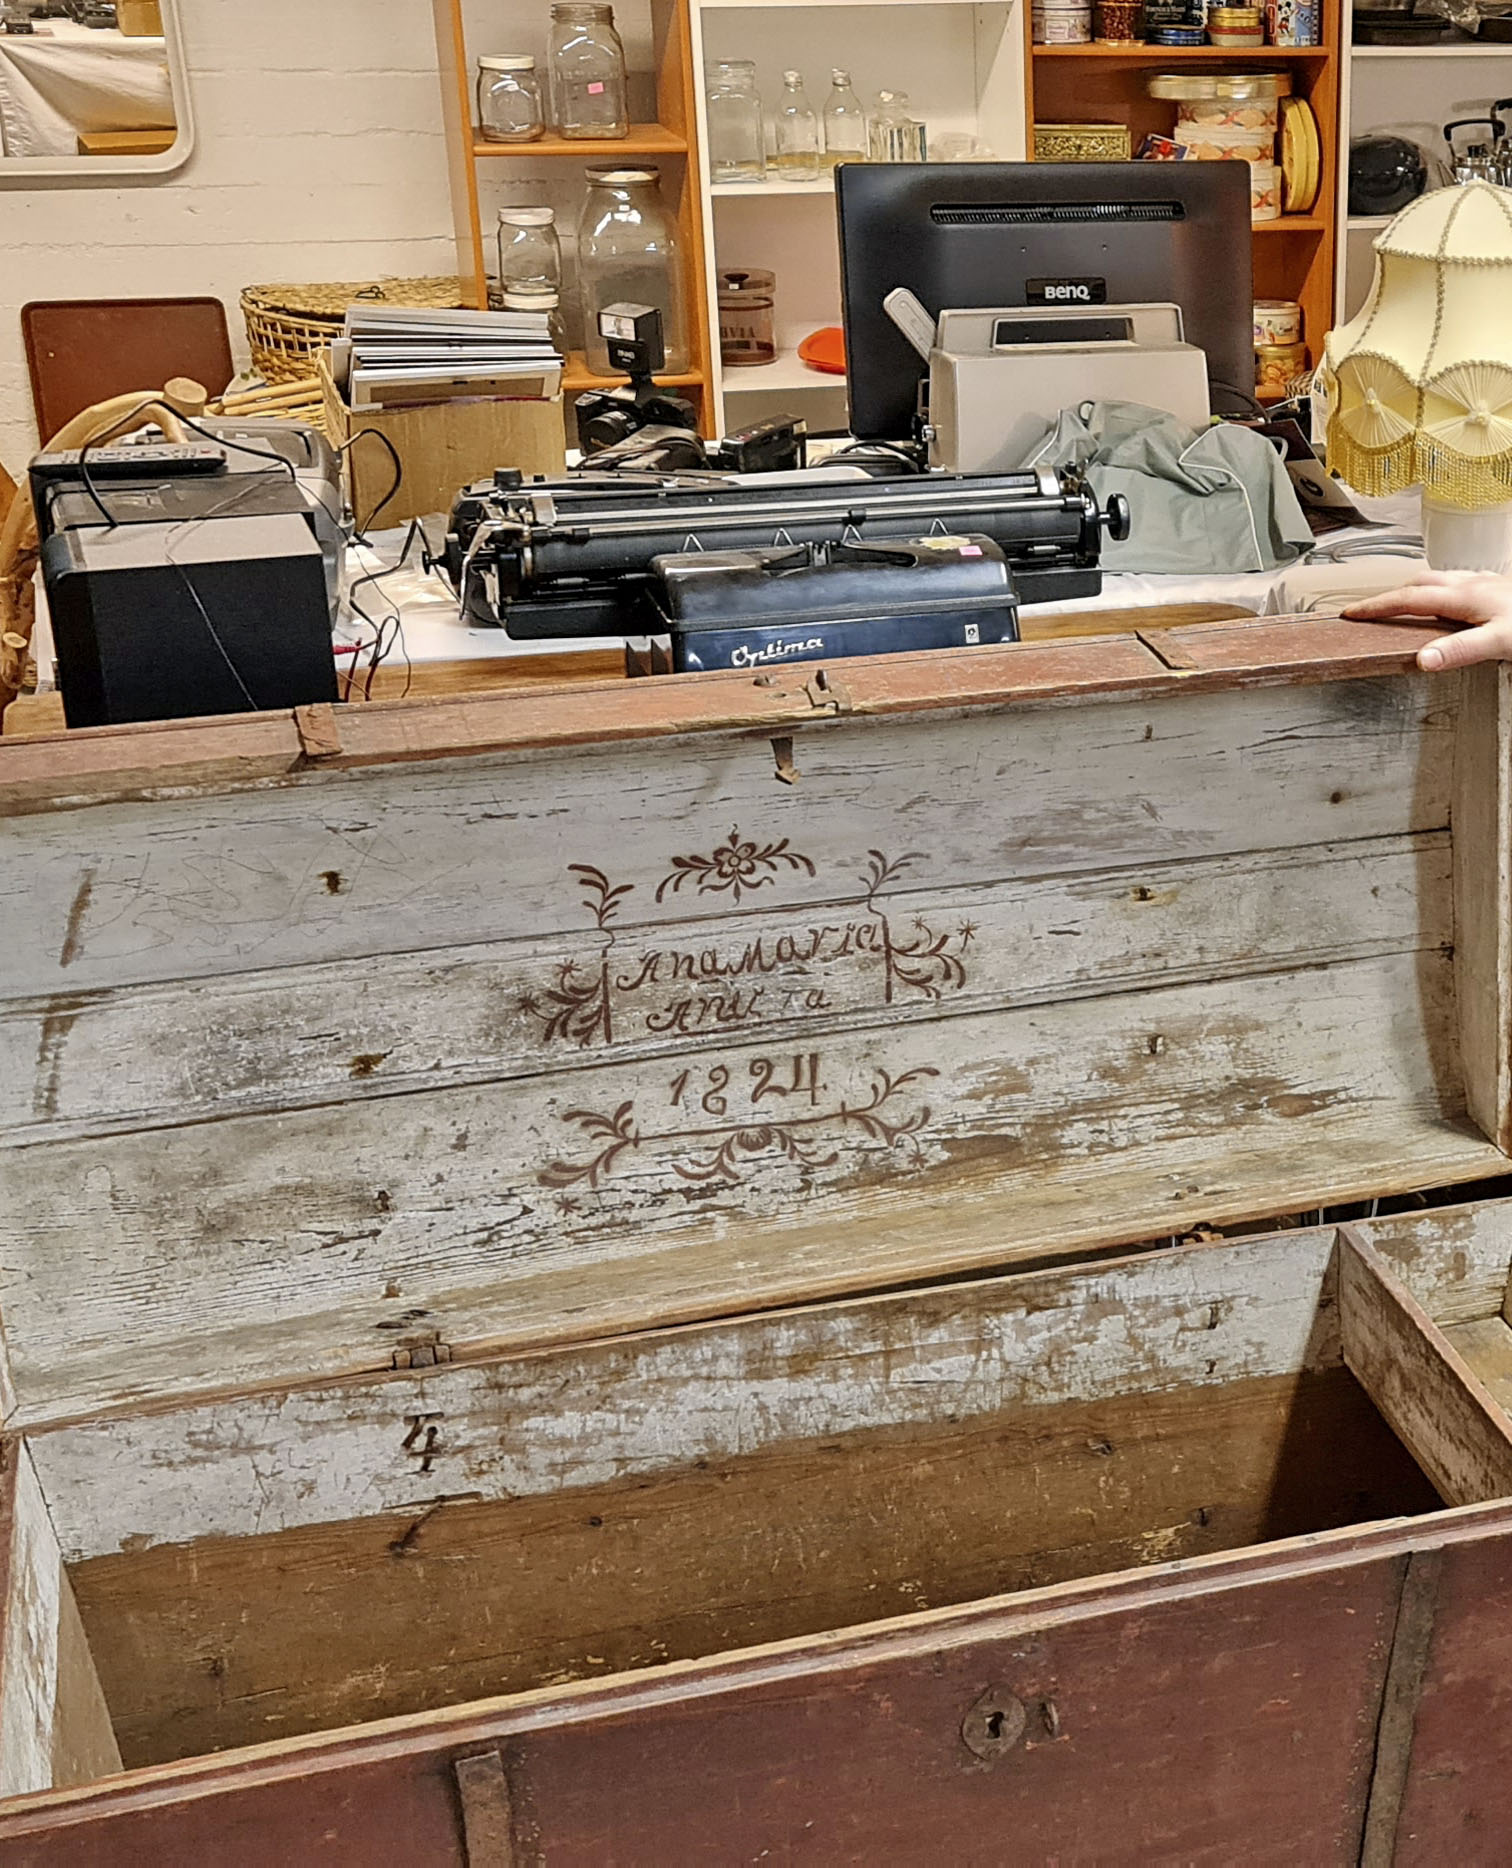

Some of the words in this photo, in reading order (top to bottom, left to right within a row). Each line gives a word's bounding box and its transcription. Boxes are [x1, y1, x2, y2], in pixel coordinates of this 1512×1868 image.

[1044, 284, 1091, 301] BenQ
[730, 637, 824, 667] Optima
[668, 1052, 828, 1116] 1824
